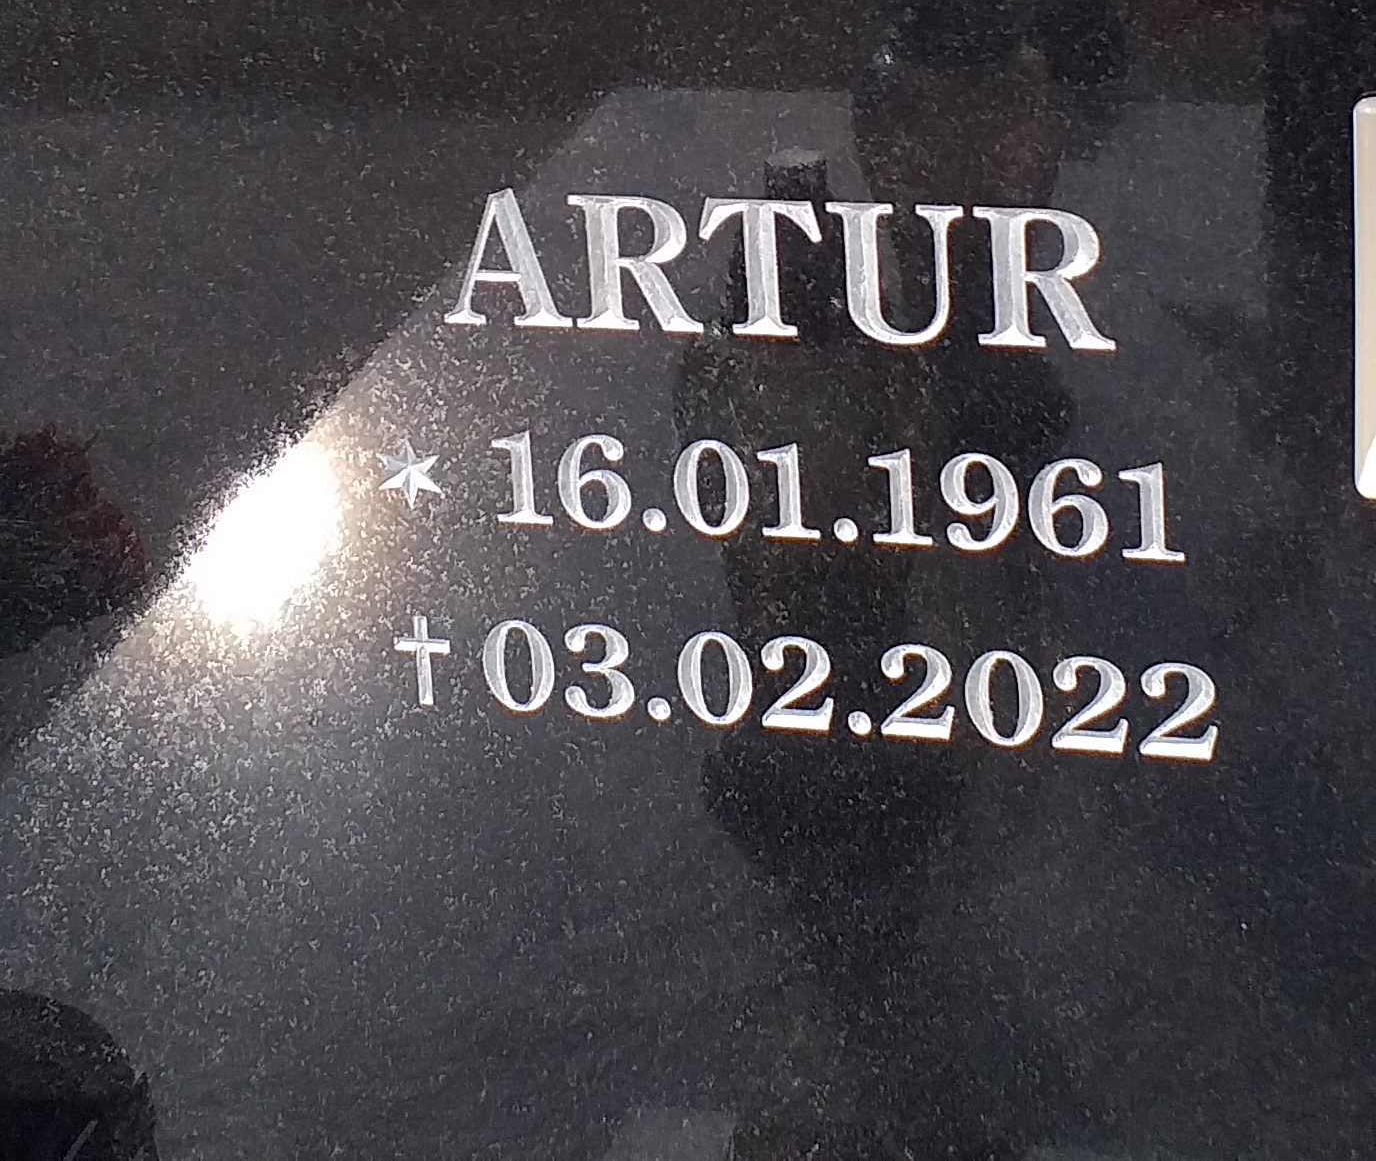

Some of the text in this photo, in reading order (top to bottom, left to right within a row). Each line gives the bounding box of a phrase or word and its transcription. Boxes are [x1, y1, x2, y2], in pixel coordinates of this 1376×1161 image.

[443, 187, 1118, 351] ARTUR
[488, 429, 1187, 562] 16.01.1961
[481, 619, 1219, 761] 03.02.2022
